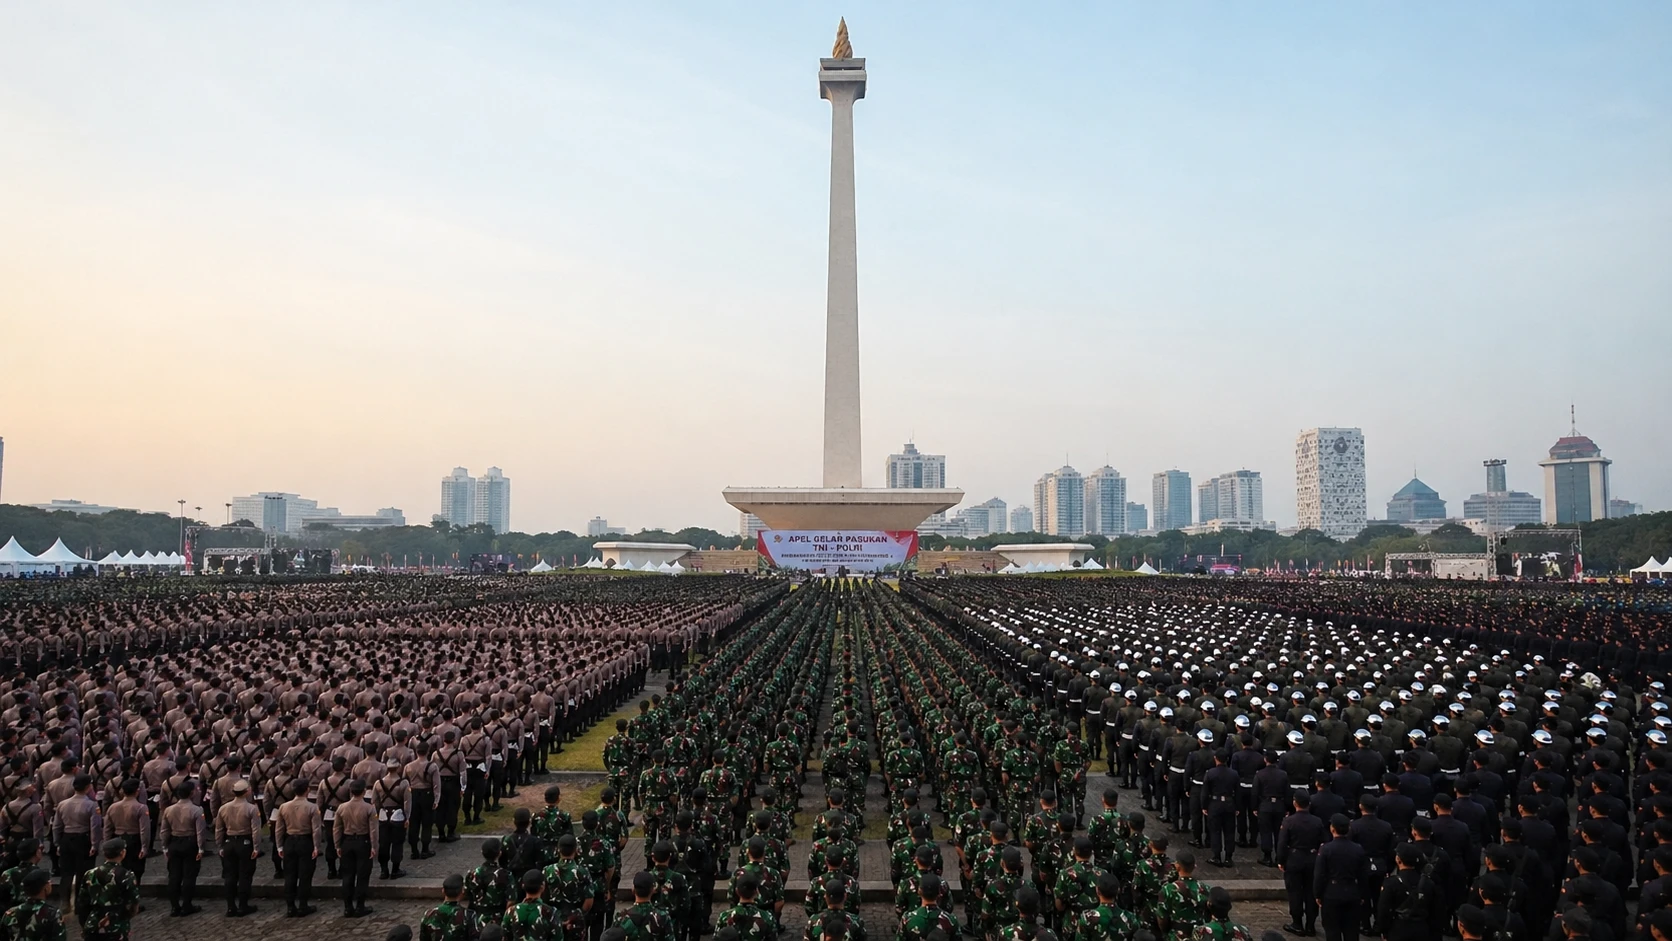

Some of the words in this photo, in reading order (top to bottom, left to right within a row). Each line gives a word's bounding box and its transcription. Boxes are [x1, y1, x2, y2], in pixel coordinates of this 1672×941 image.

[788, 535, 811, 543] APEL
[814, 535, 843, 543] GELAR
[846, 535, 888, 543] PASUKAN
[812, 544, 828, 552] TNI
